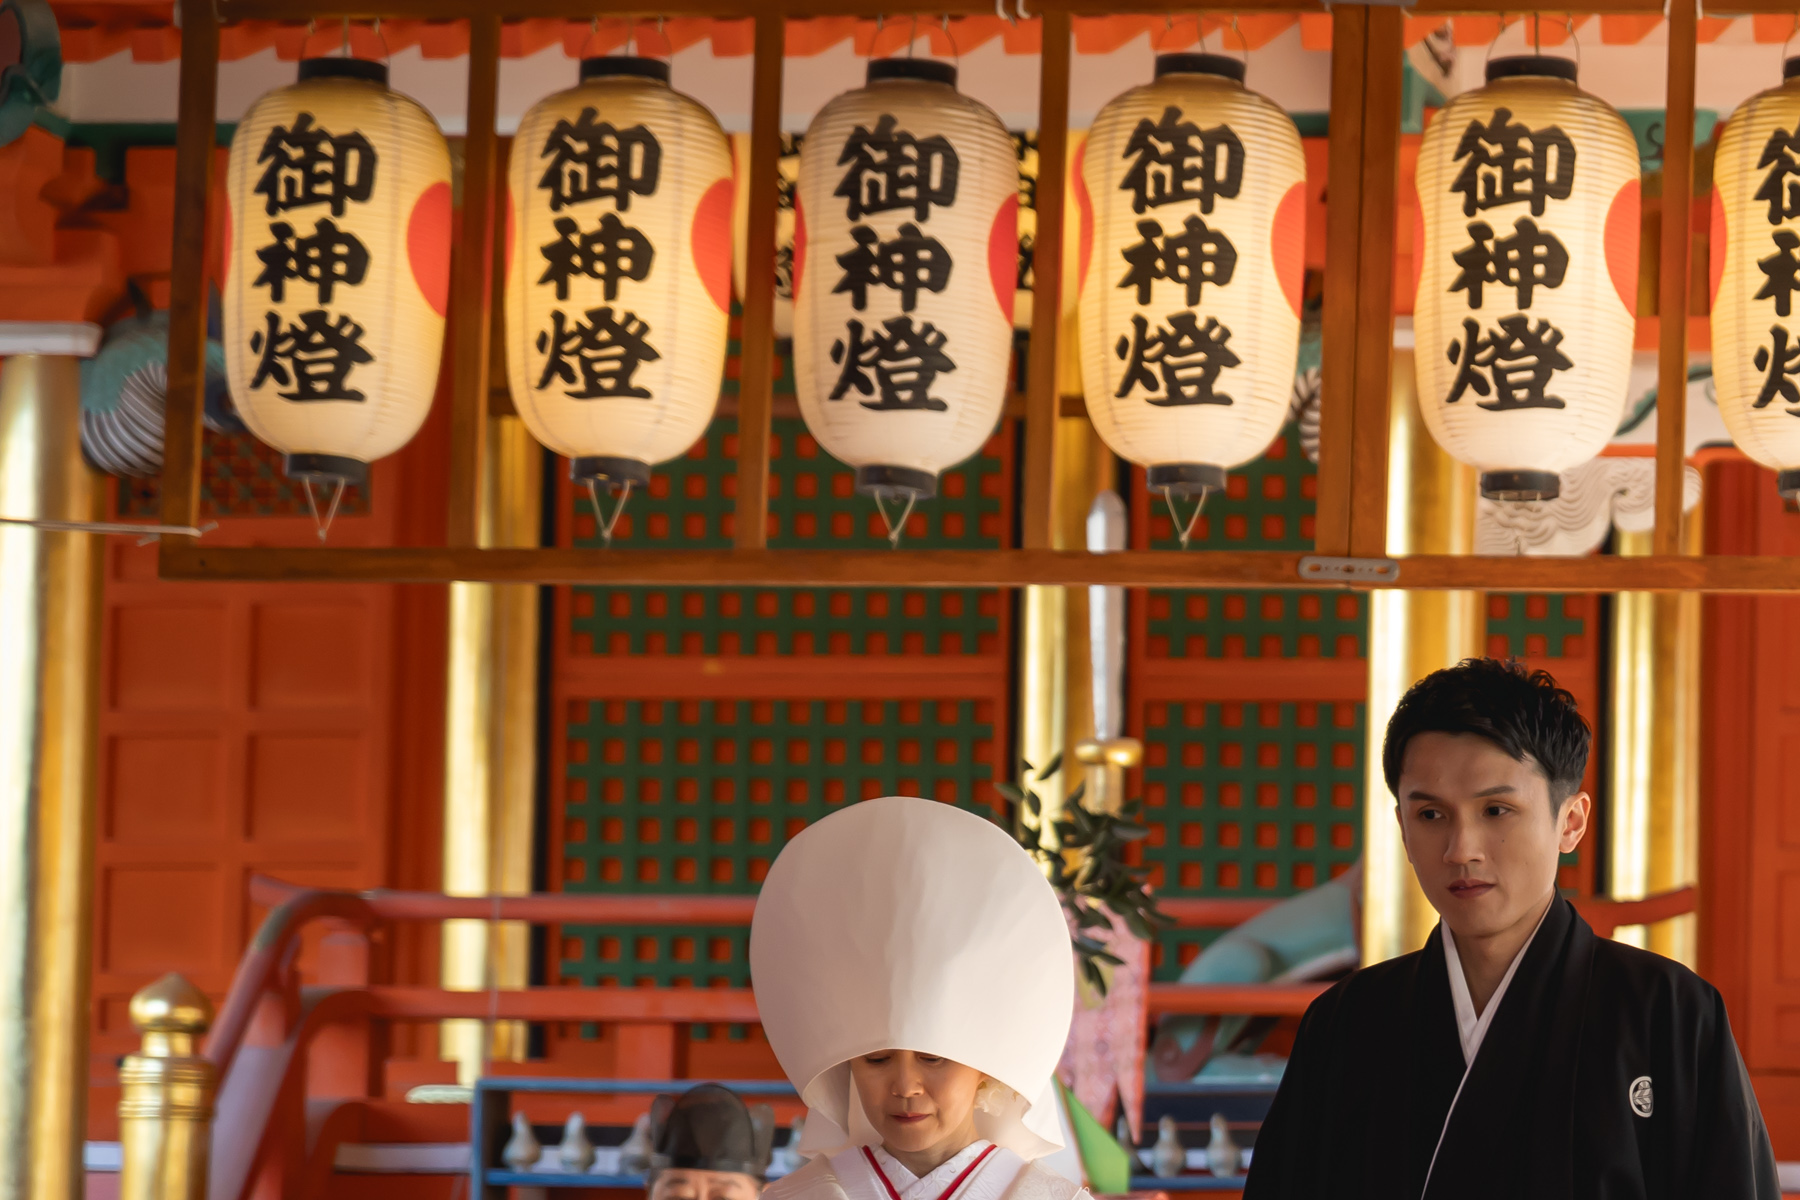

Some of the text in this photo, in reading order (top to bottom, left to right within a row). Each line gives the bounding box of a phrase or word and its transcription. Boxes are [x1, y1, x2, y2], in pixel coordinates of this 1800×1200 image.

[249, 111, 379, 404] 御神燈
[534, 107, 663, 401] 御神燈
[826, 114, 962, 413] 御神燈
[1113, 106, 1246, 408] 御神燈
[1446, 108, 1578, 412] 御神燈
